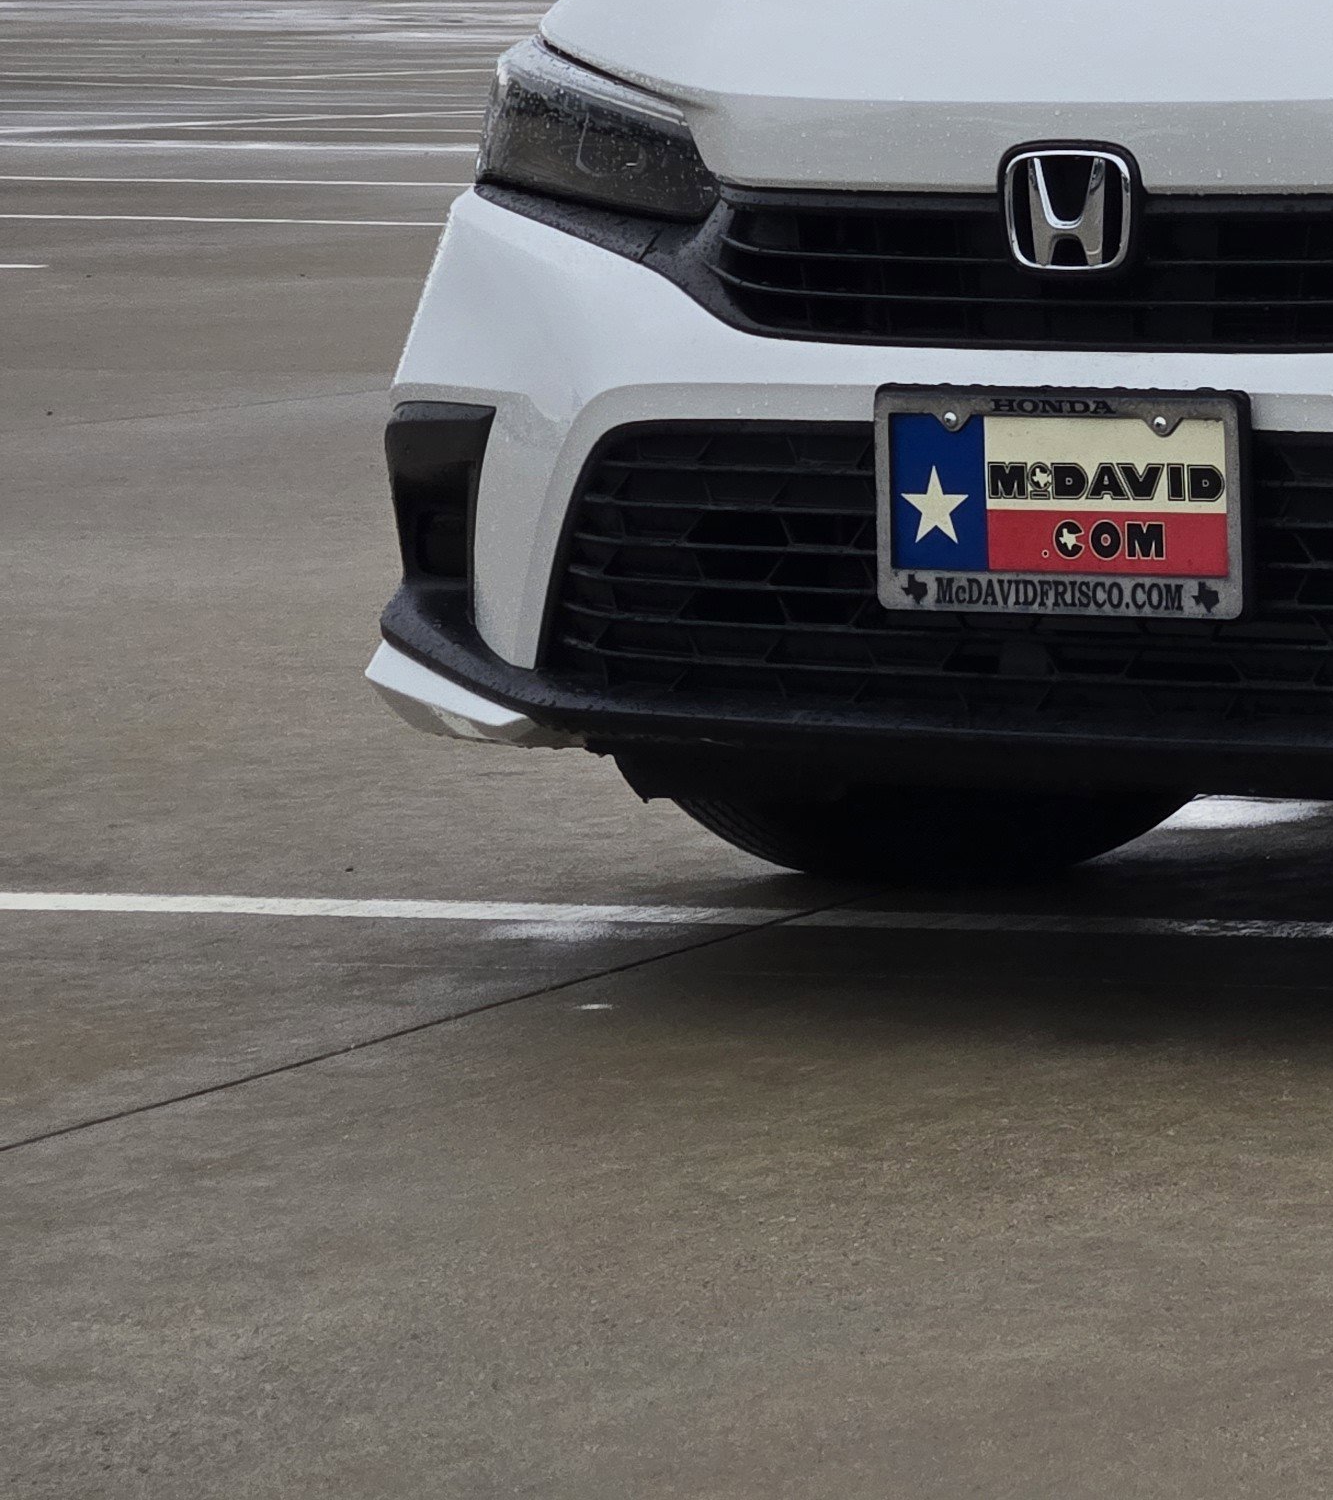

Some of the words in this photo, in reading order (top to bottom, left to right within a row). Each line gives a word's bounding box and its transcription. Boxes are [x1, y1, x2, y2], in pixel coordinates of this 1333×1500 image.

[991, 399, 1117, 415] HONDA
[1041, 519, 1166, 561] .COM
[935, 576, 1184, 612] McDAVIDFRISCO.COM
